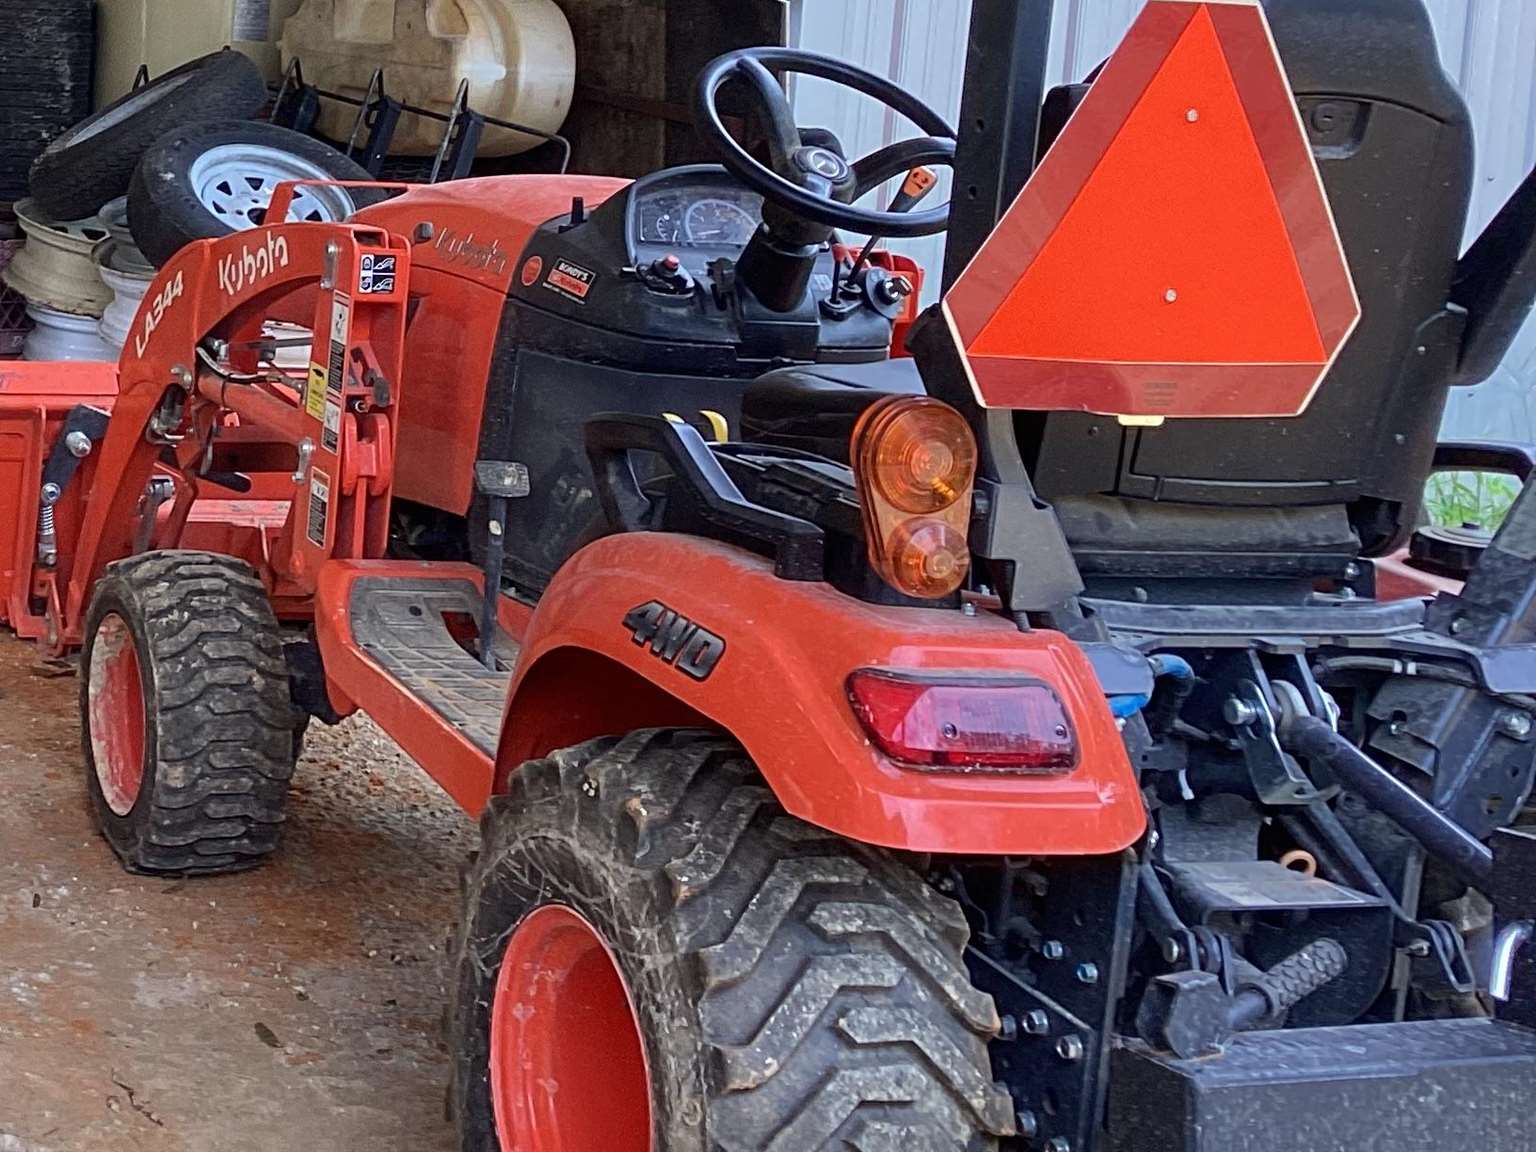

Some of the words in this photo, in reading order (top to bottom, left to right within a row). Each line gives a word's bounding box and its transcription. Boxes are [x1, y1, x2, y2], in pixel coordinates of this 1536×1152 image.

[219, 230, 289, 296] Kubota
[135, 270, 184, 359] LA344
[621, 598, 727, 682] 4WD
